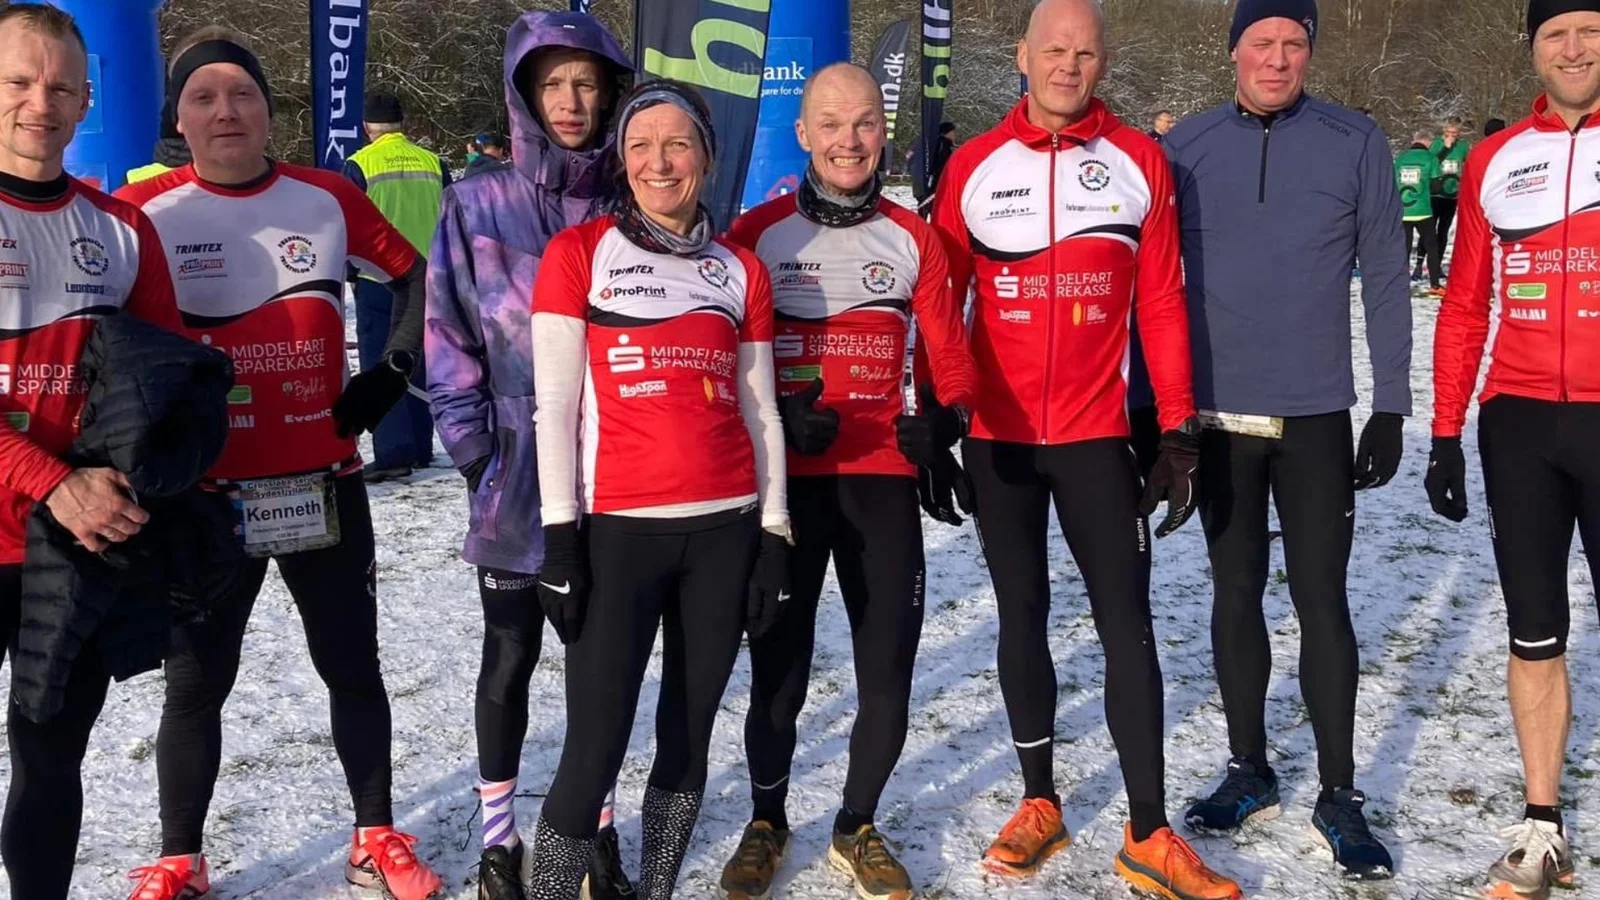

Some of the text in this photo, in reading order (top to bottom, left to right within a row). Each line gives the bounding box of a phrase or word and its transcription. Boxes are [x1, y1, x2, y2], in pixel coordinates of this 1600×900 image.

[780, 86, 792, 96] for
[1507, 161, 1550, 179] TRIMTEX
[991, 188, 1031, 200] TRIMTEX
[175, 243, 223, 255] TRIMTEX
[609, 264, 655, 279] TRIMTEX
[780, 262, 822, 271] TRIMTEX
[1534, 260, 1600, 275] SPAREK
[614, 286, 667, 297] ProPrint
[808, 333, 895, 347] MIDDELFART
[232, 338, 326, 360] MIDDELFART
[651, 346, 737, 367] MIDDELFART
[808, 345, 895, 360] SPAREKASSE
[17, 363, 79, 379] MIDDE
[233, 353, 326, 375] SPAREKASSE
[651, 357, 732, 378] SPAREKASSE
[246, 500, 322, 523] Kenneth
[1136, 517, 1146, 552] FUSION
